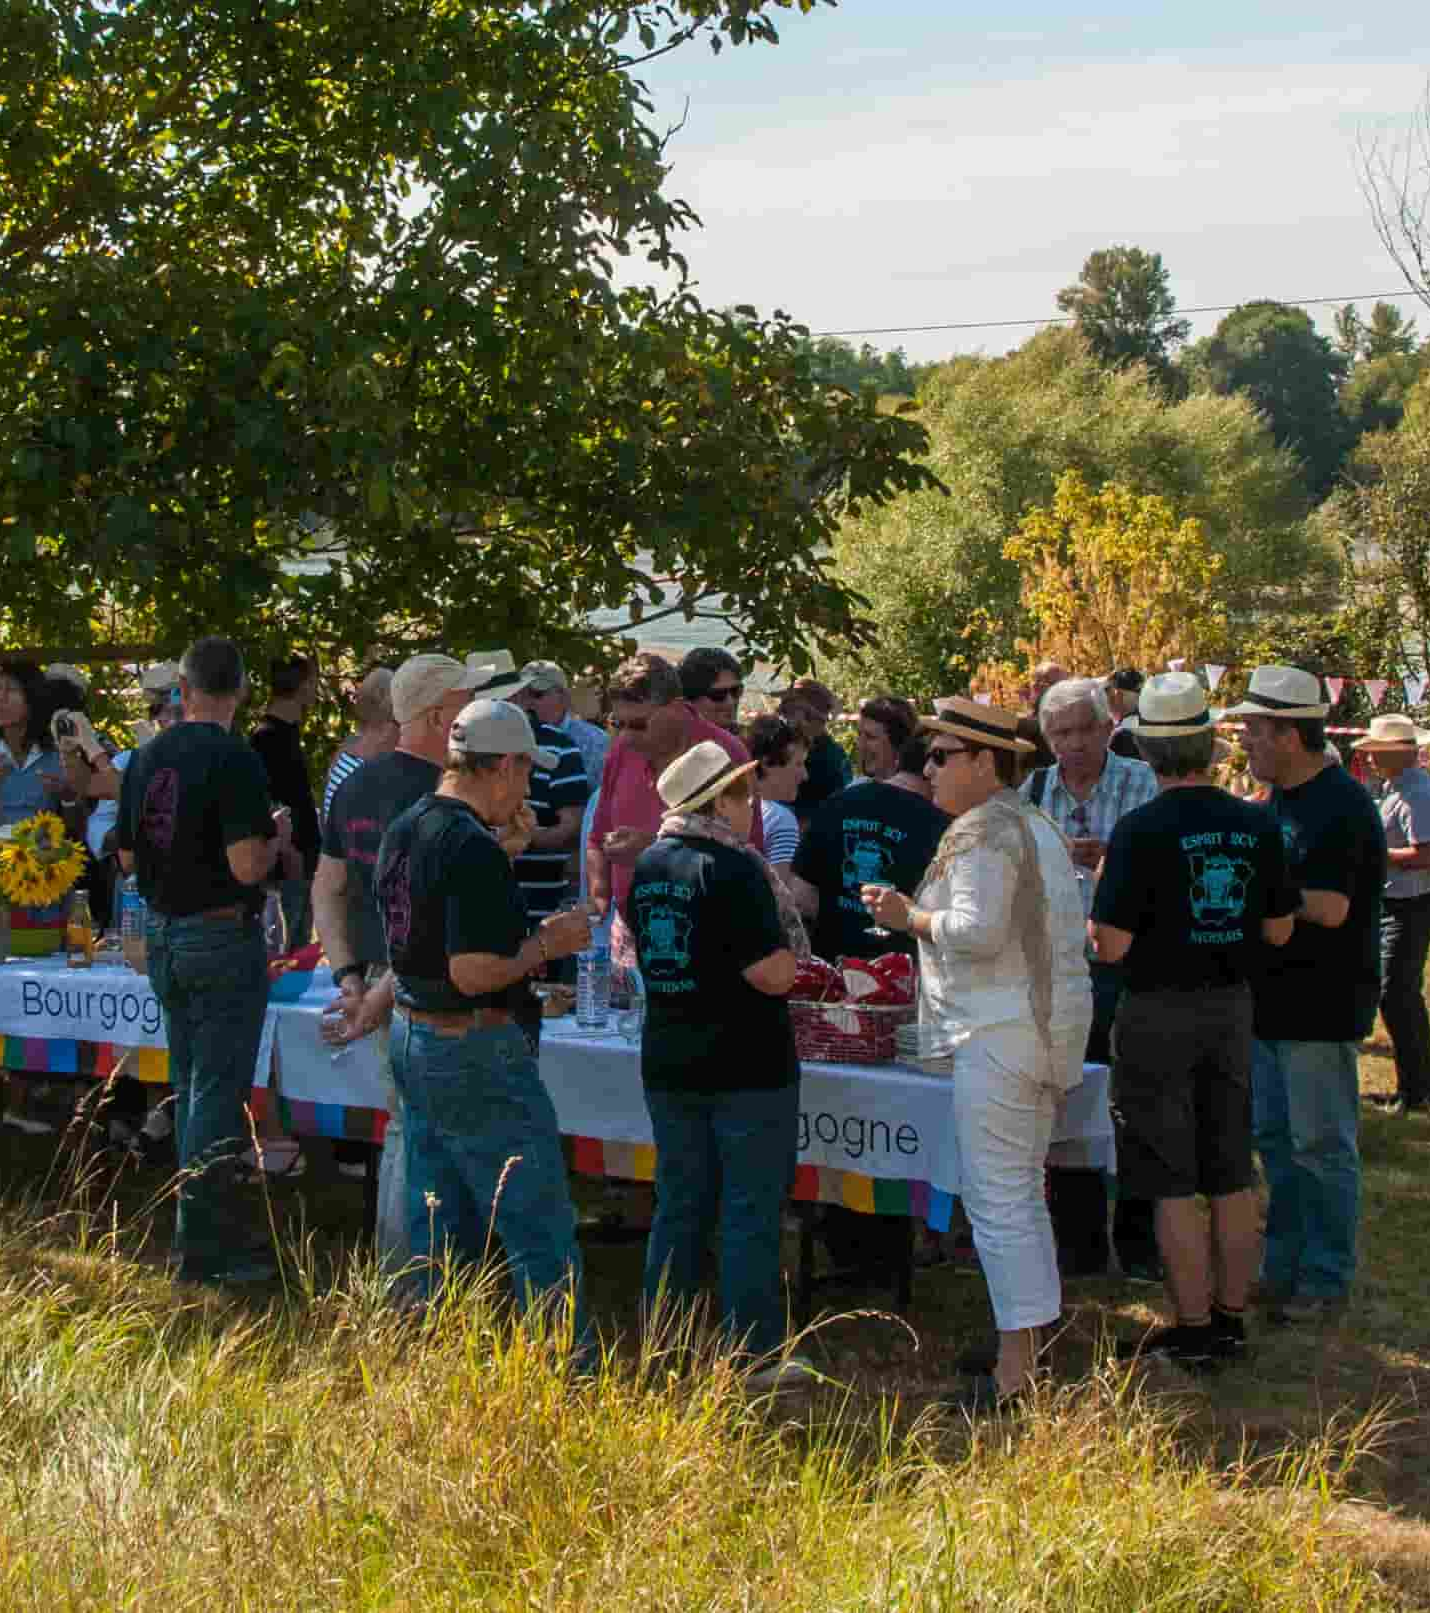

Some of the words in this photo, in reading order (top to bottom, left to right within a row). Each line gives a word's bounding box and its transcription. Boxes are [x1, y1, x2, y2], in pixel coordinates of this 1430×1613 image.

[1181, 831, 1223, 849] ESPRIT
[22, 980, 161, 1034] Bourgog
[795, 1111, 919, 1159] gogne
